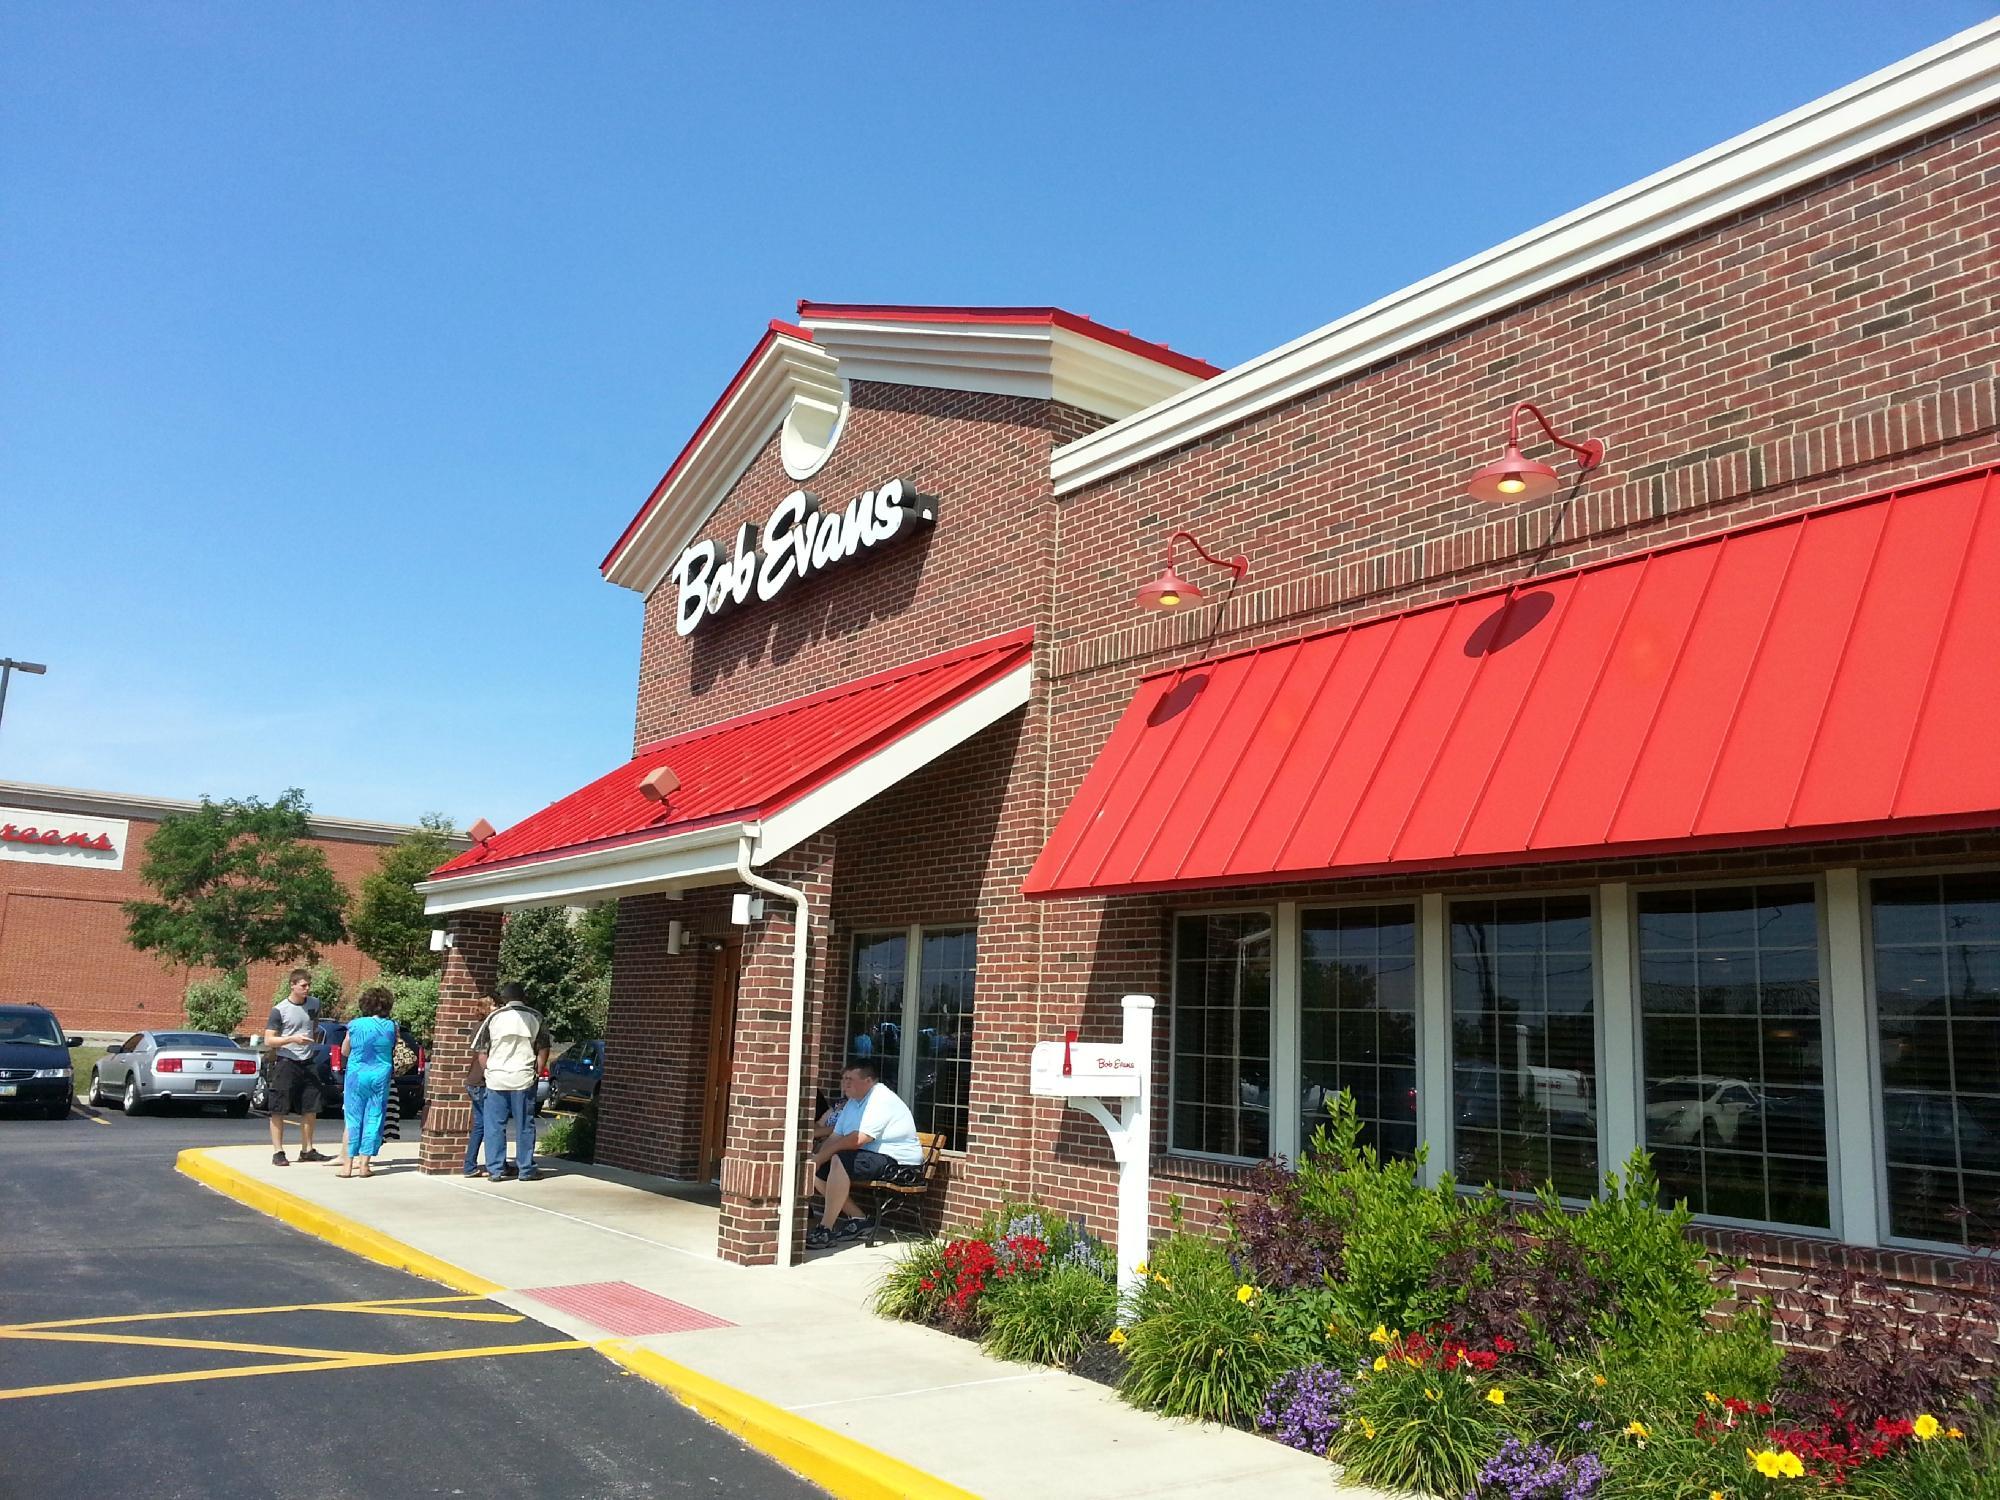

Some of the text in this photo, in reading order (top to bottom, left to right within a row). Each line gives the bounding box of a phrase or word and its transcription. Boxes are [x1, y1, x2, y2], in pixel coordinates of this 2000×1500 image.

[671, 478, 904, 637] Bob Evans
[1096, 1058, 1135, 1070] Bob Evans
